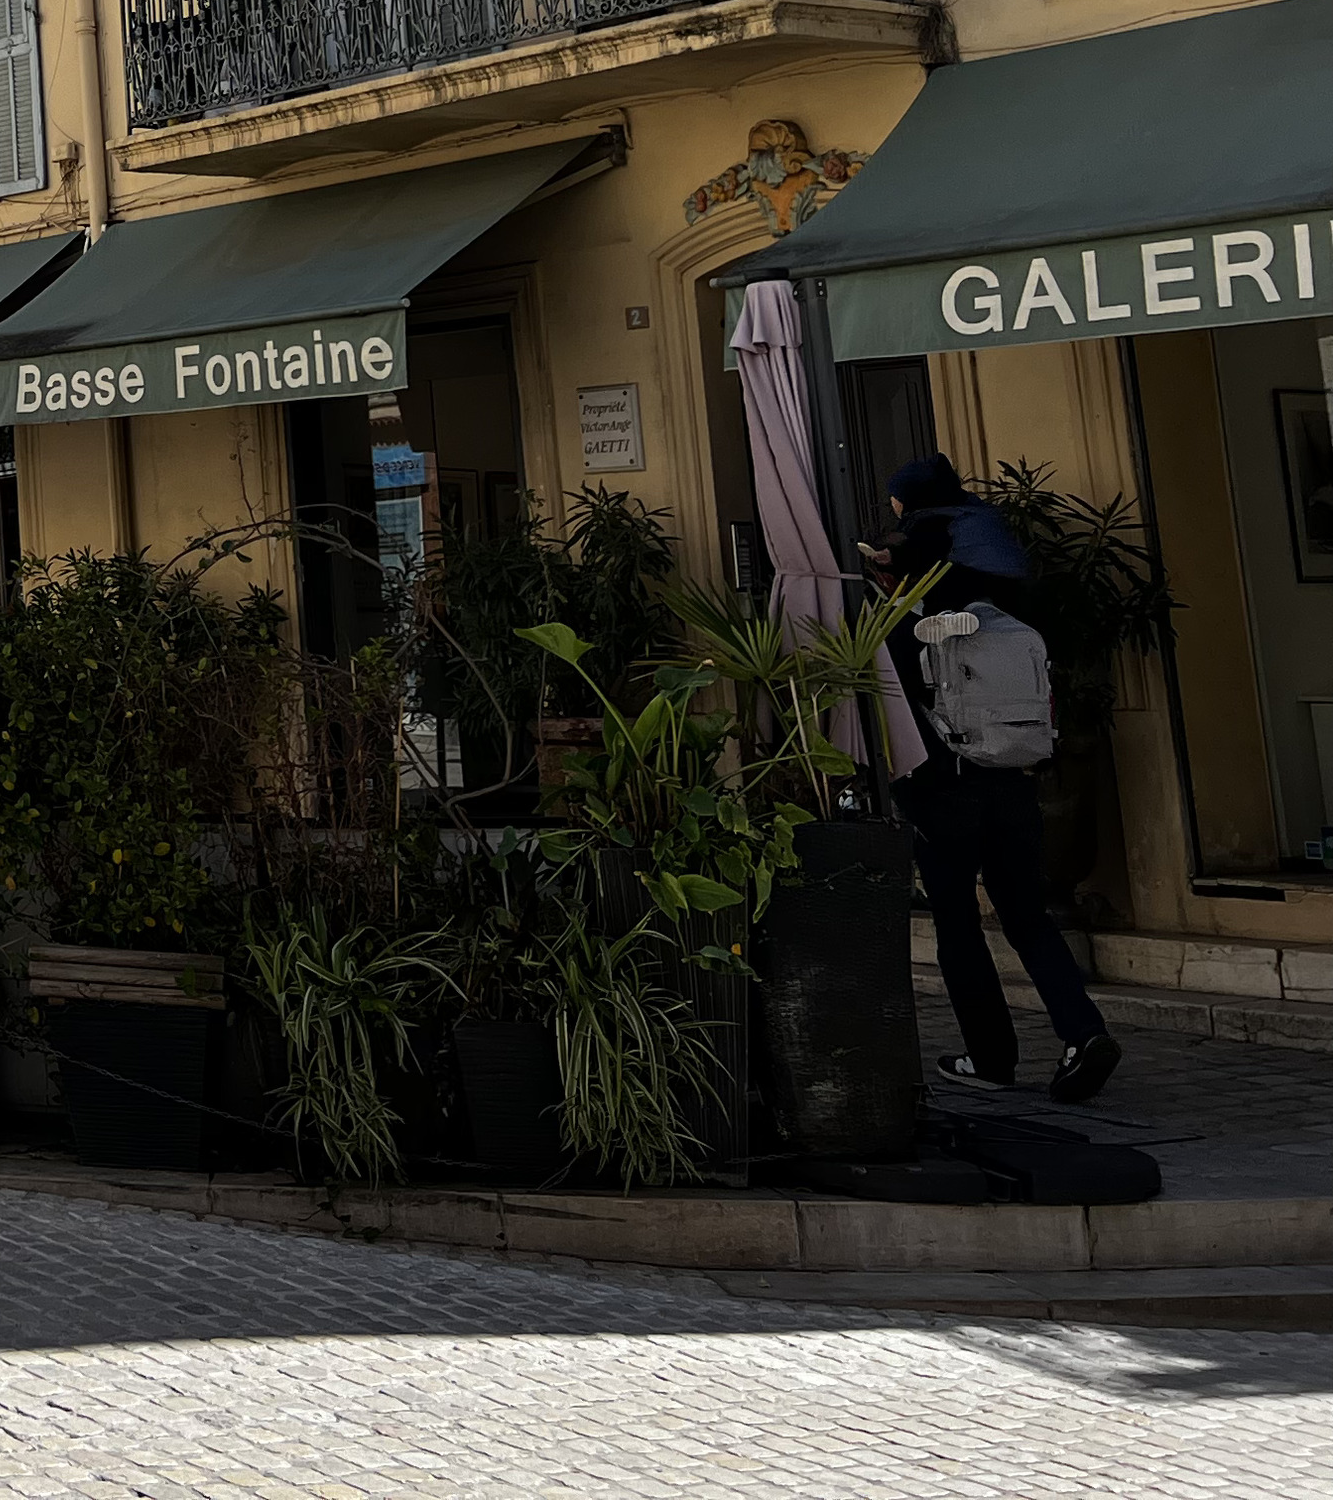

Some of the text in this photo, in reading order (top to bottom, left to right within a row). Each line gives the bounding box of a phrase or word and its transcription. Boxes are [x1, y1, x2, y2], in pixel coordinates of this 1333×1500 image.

[940, 219, 1333, 336] GALERI
[630, 309, 642, 326] 2
[15, 363, 146, 415] Basse
[174, 329, 395, 400] Fontaine
[582, 401, 627, 418] Propriété
[584, 439, 631, 455] GAETTI
